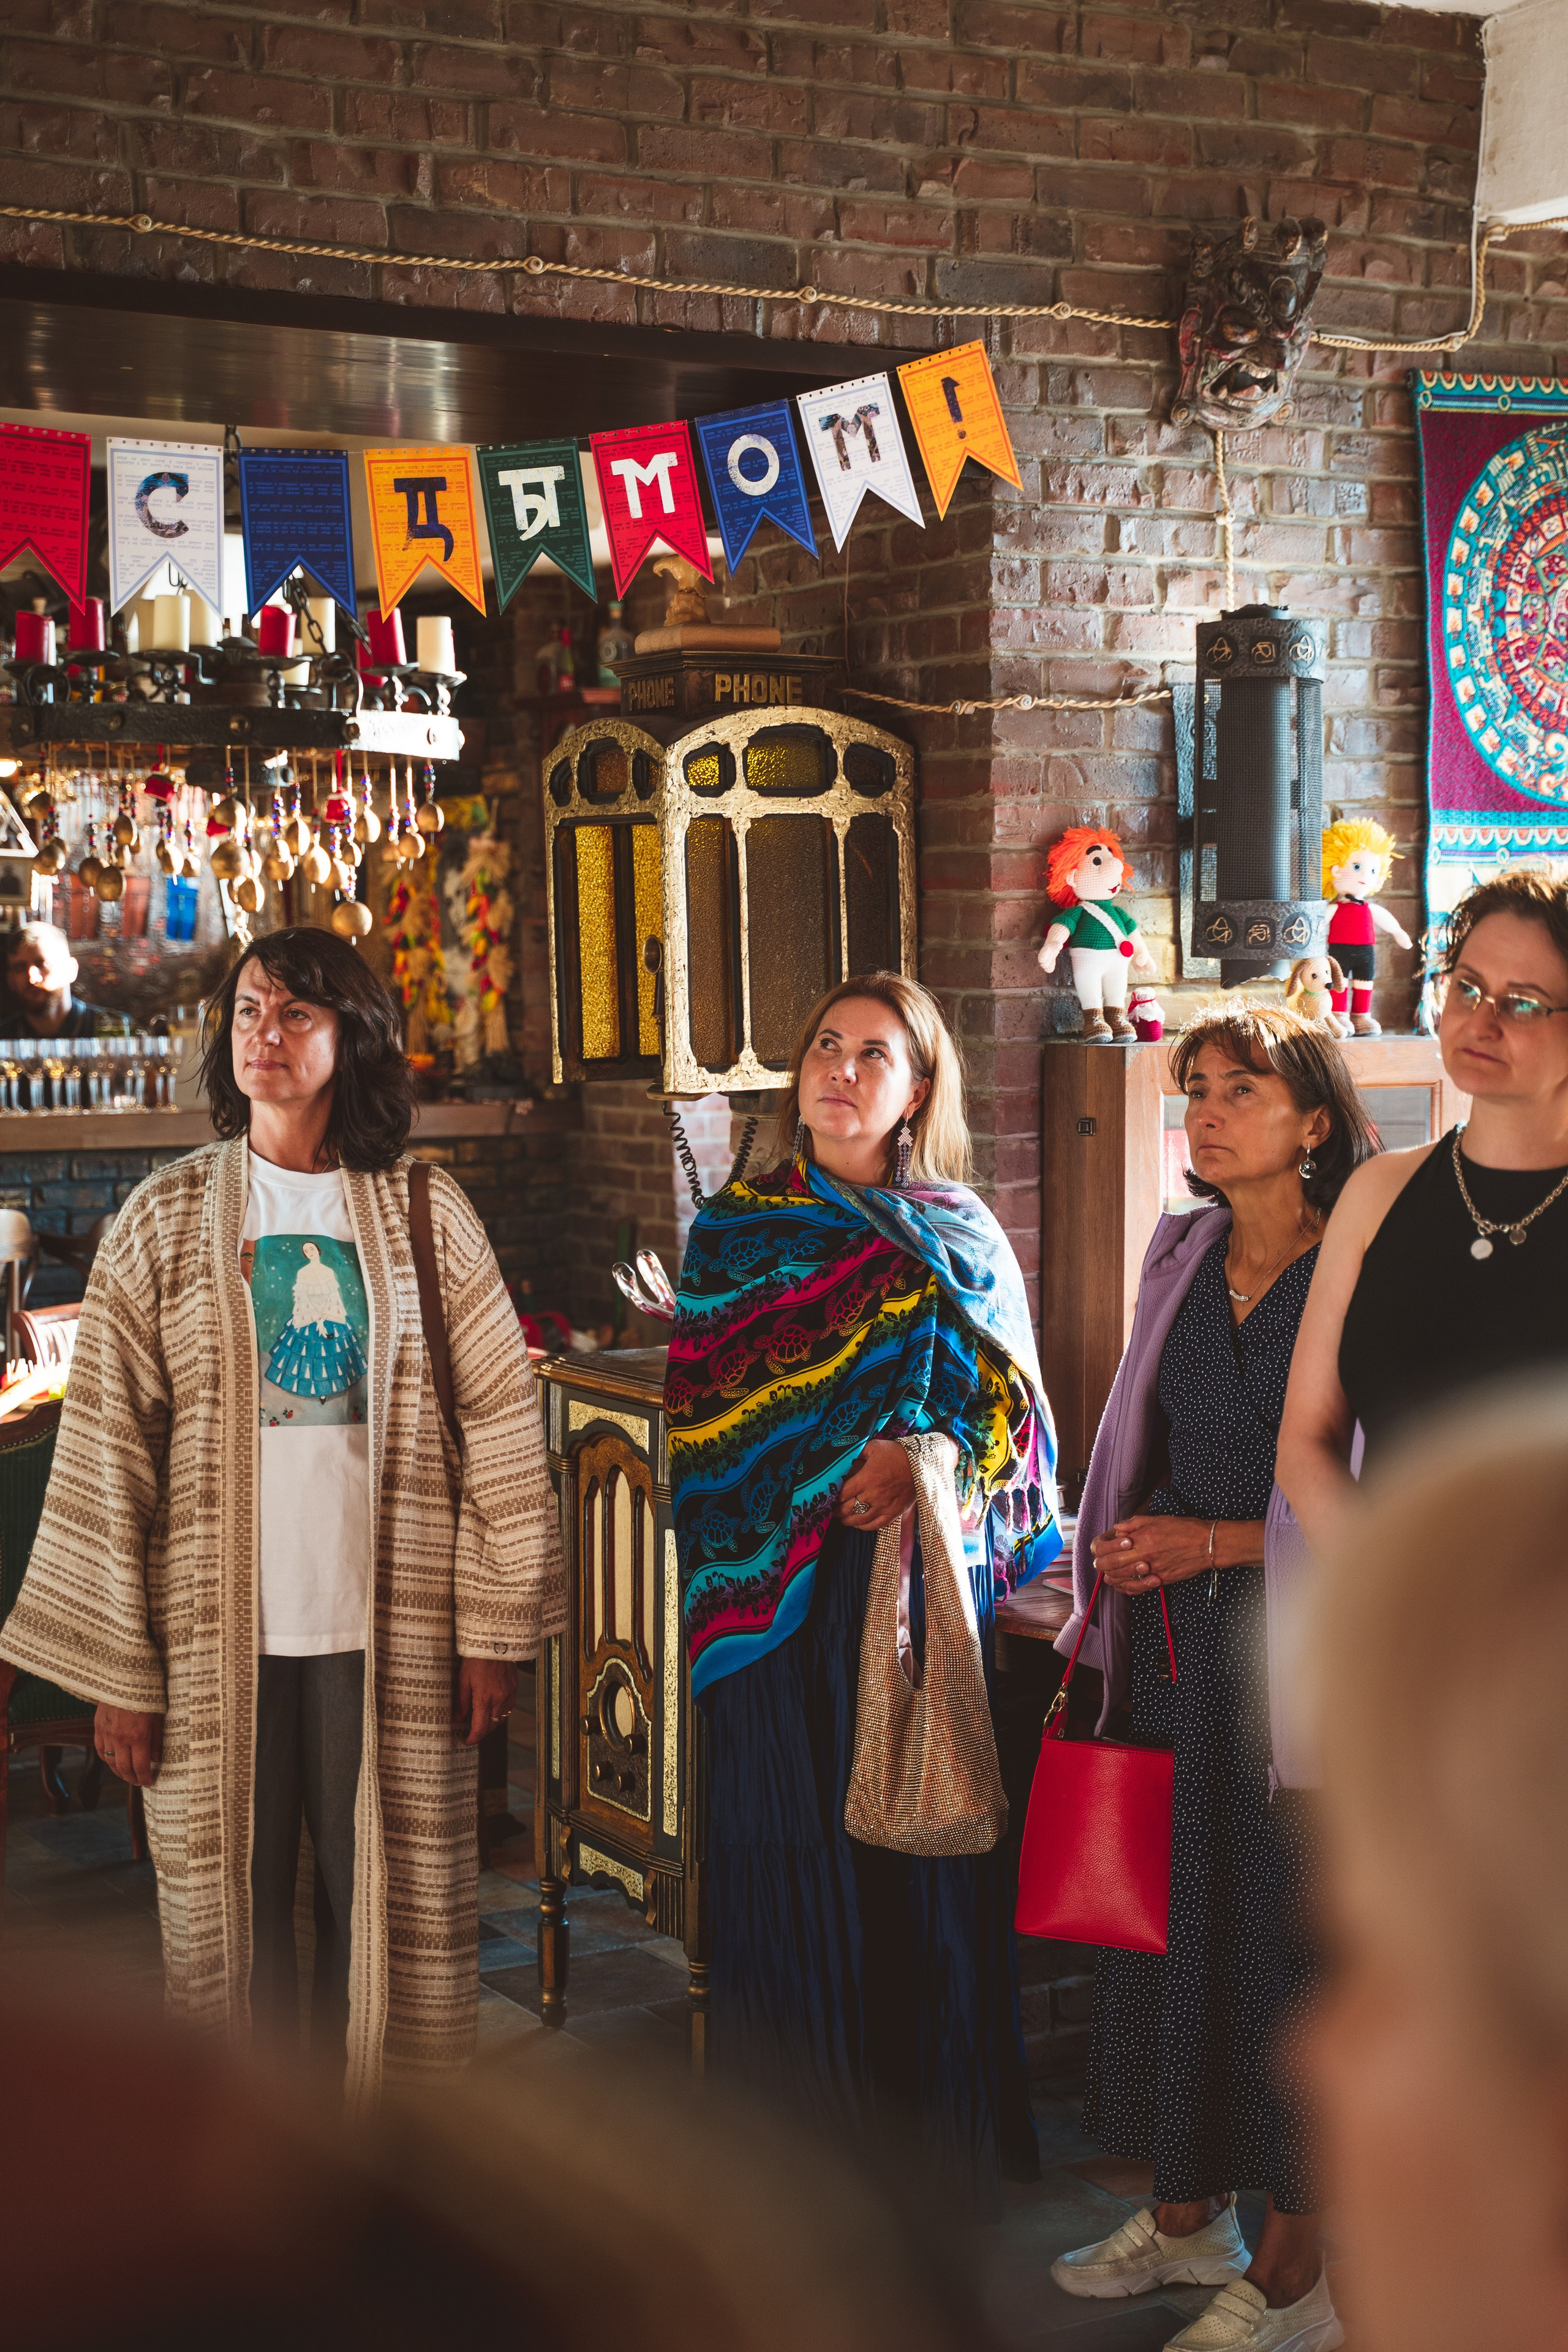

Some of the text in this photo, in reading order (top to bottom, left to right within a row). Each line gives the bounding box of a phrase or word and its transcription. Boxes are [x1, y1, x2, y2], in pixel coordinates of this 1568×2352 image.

[135, 472, 189, 539] С
[628, 676, 674, 712] PHONE
[714, 673, 803, 705] PHONE
